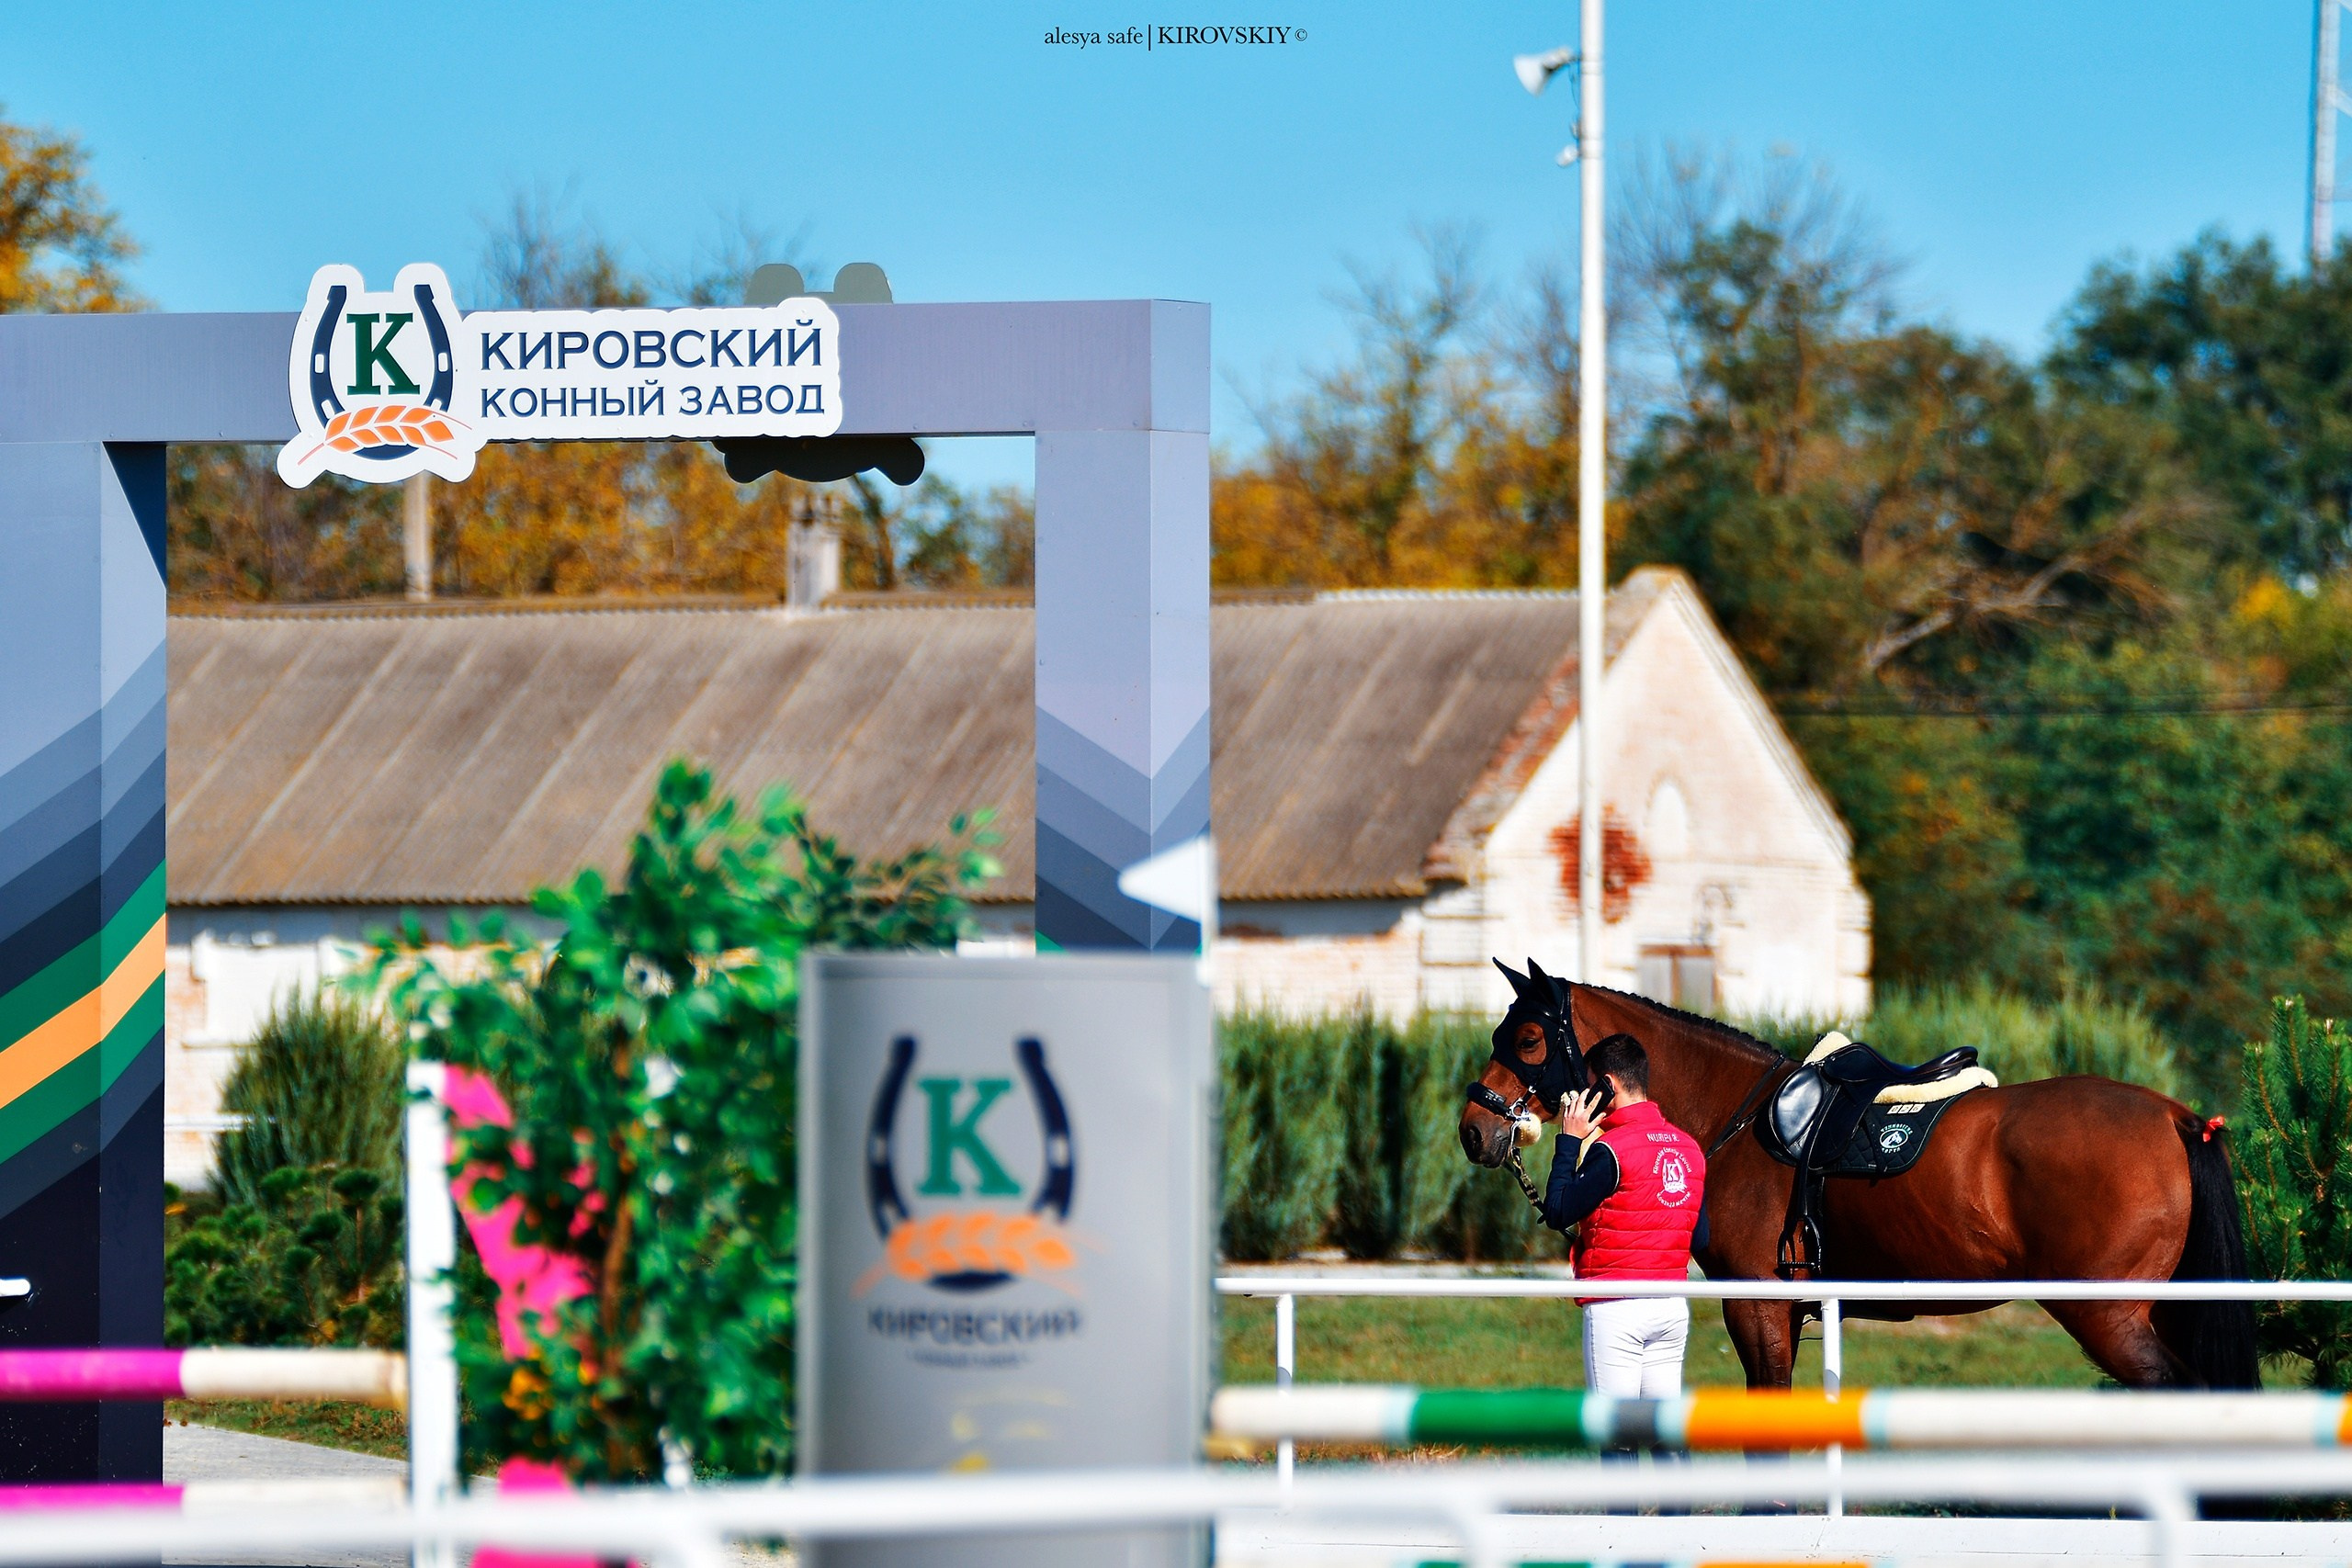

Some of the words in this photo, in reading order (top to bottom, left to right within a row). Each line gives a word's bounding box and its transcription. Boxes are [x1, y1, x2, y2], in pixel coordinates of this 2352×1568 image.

[481, 319, 822, 370] КИРОВСКИЙ
[481, 379, 665, 418] КОННЫЙ
[678, 384, 825, 416] ЗАВОД
